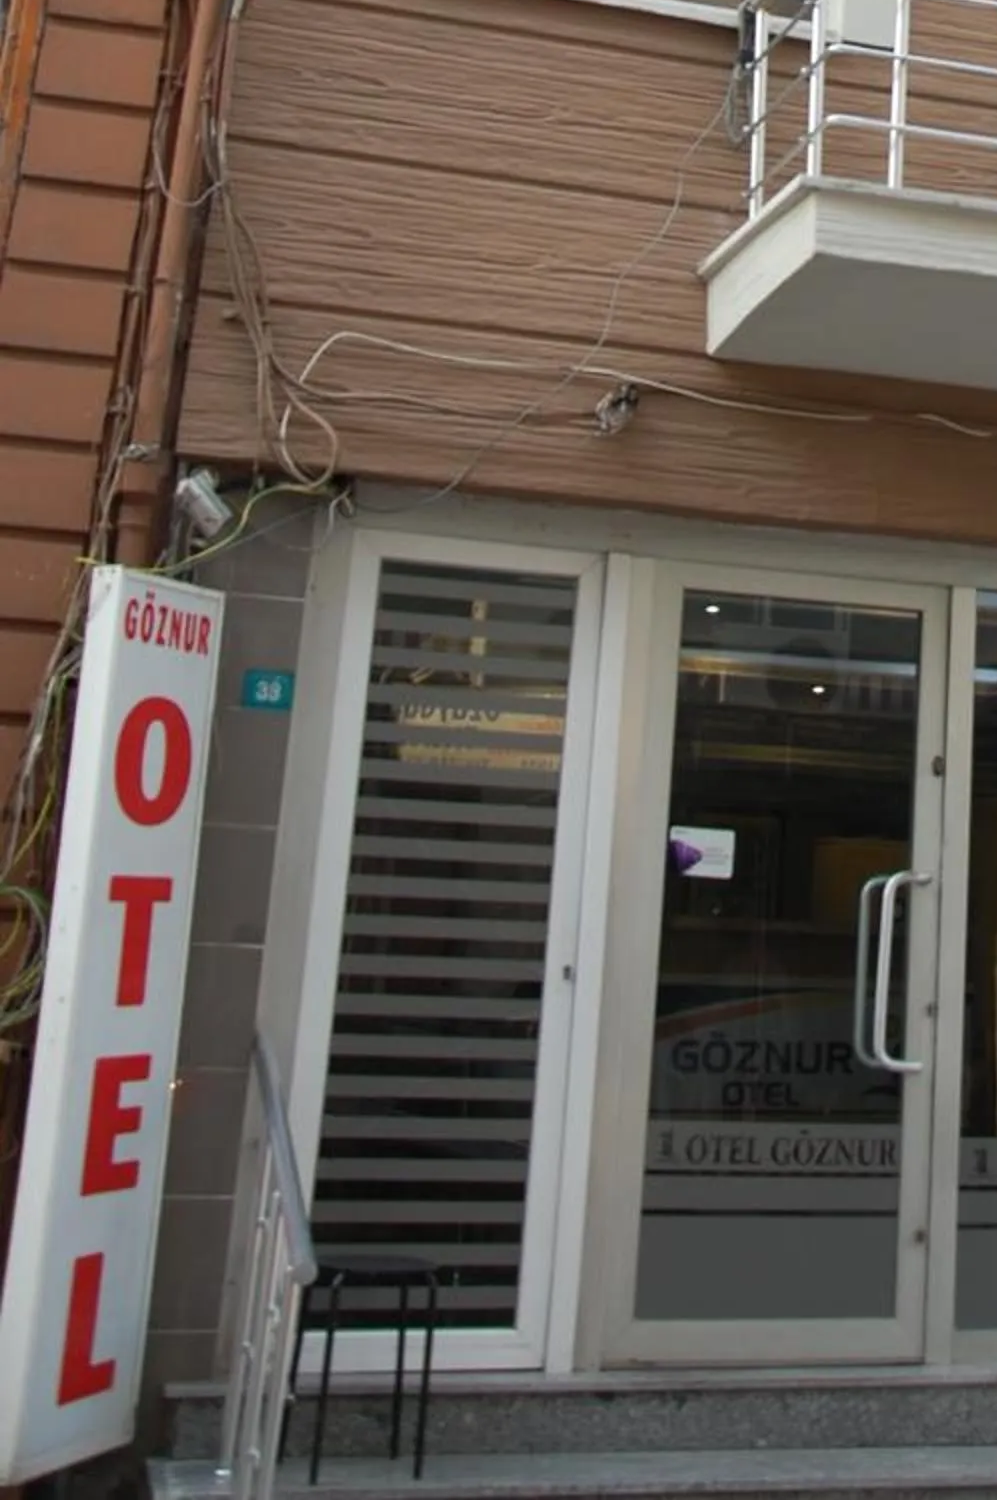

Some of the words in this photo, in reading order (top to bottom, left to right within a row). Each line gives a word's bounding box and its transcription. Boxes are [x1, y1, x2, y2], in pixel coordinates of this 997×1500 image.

[124, 587, 211, 656] GÖZNUR
[57, 696, 192, 1406] OTEL
[671, 1032, 854, 1075] GÖZNUR
[721, 1082, 800, 1107] OTEL
[685, 1134, 761, 1167] OTEL
[771, 1130, 897, 1167] GÖZNUR
